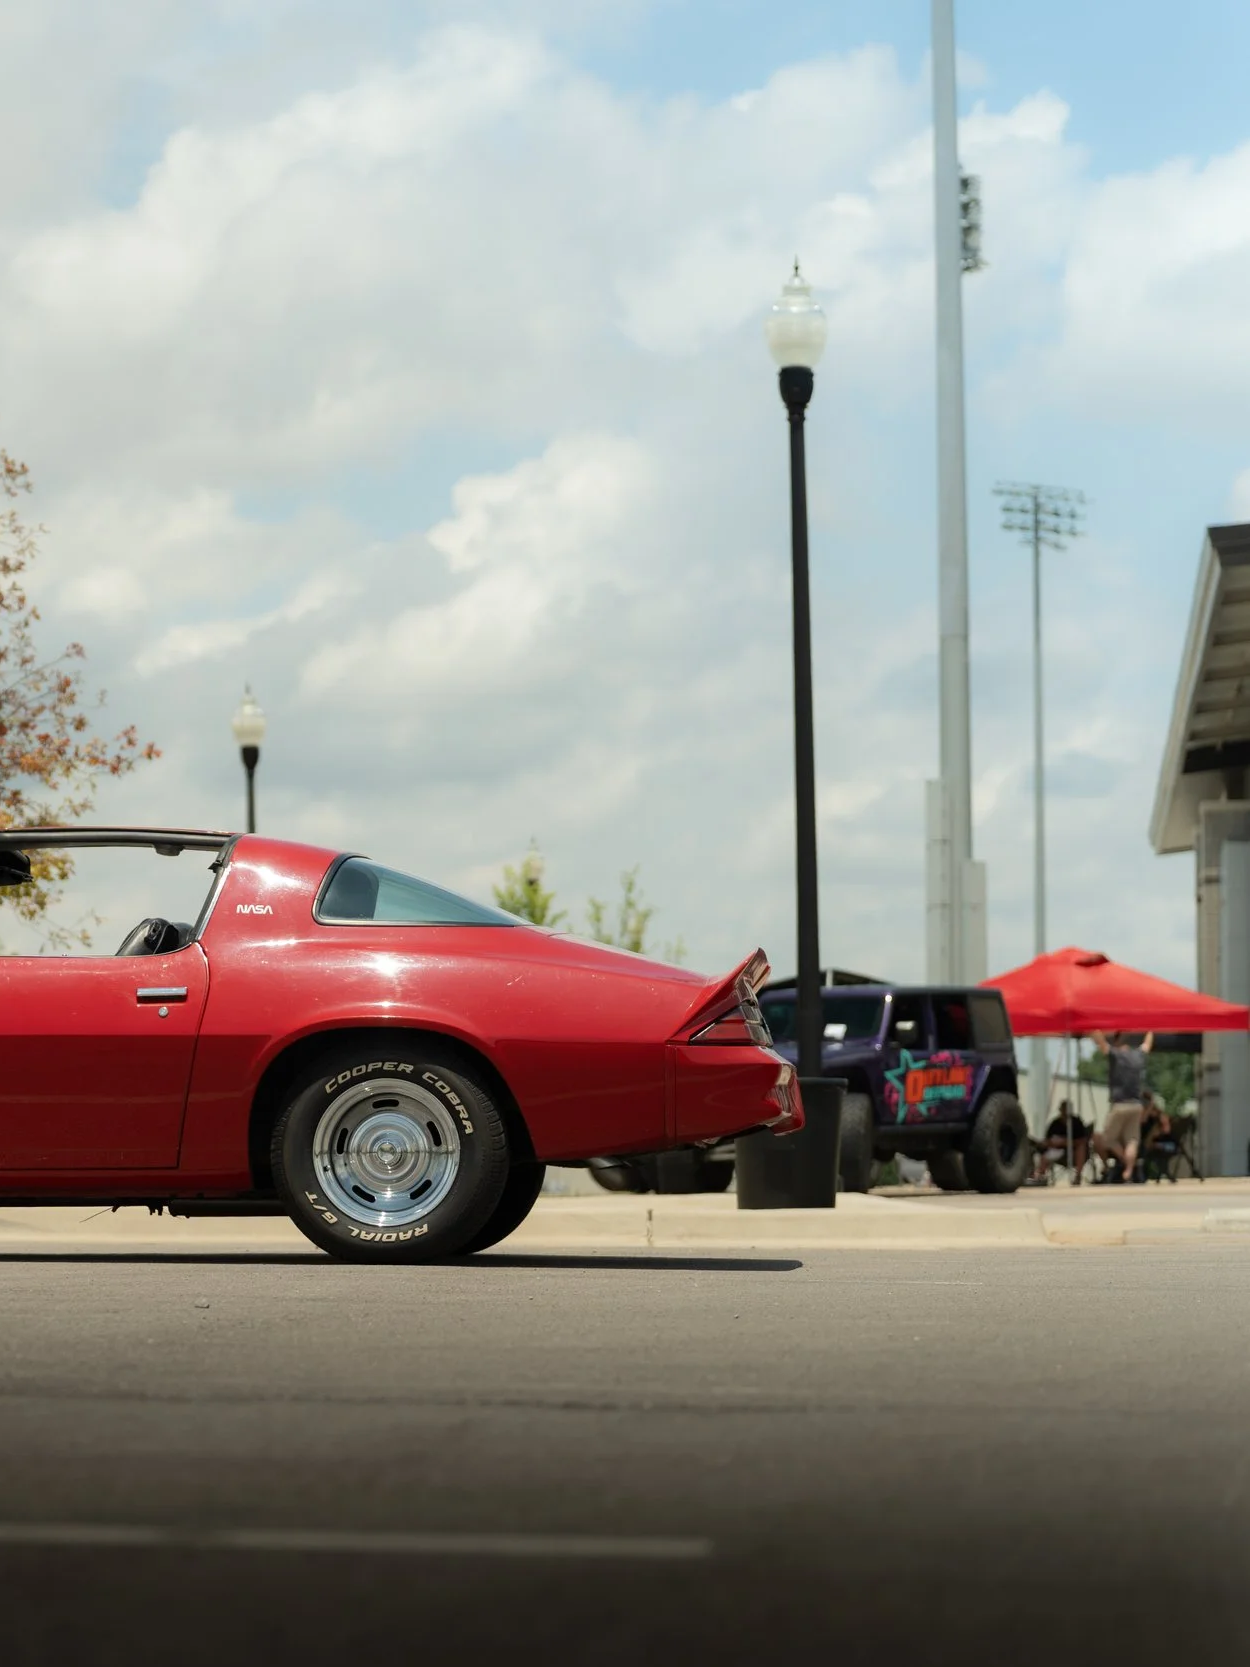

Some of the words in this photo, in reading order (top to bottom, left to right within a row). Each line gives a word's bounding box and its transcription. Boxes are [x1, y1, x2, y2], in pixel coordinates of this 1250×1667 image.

[236, 904, 273, 918] NASA
[324, 1061, 414, 1094] COOPER
[421, 1071, 474, 1135] COBRA
[304, 1190, 338, 1225] G/T
[348, 1223, 429, 1243] RADIAL
